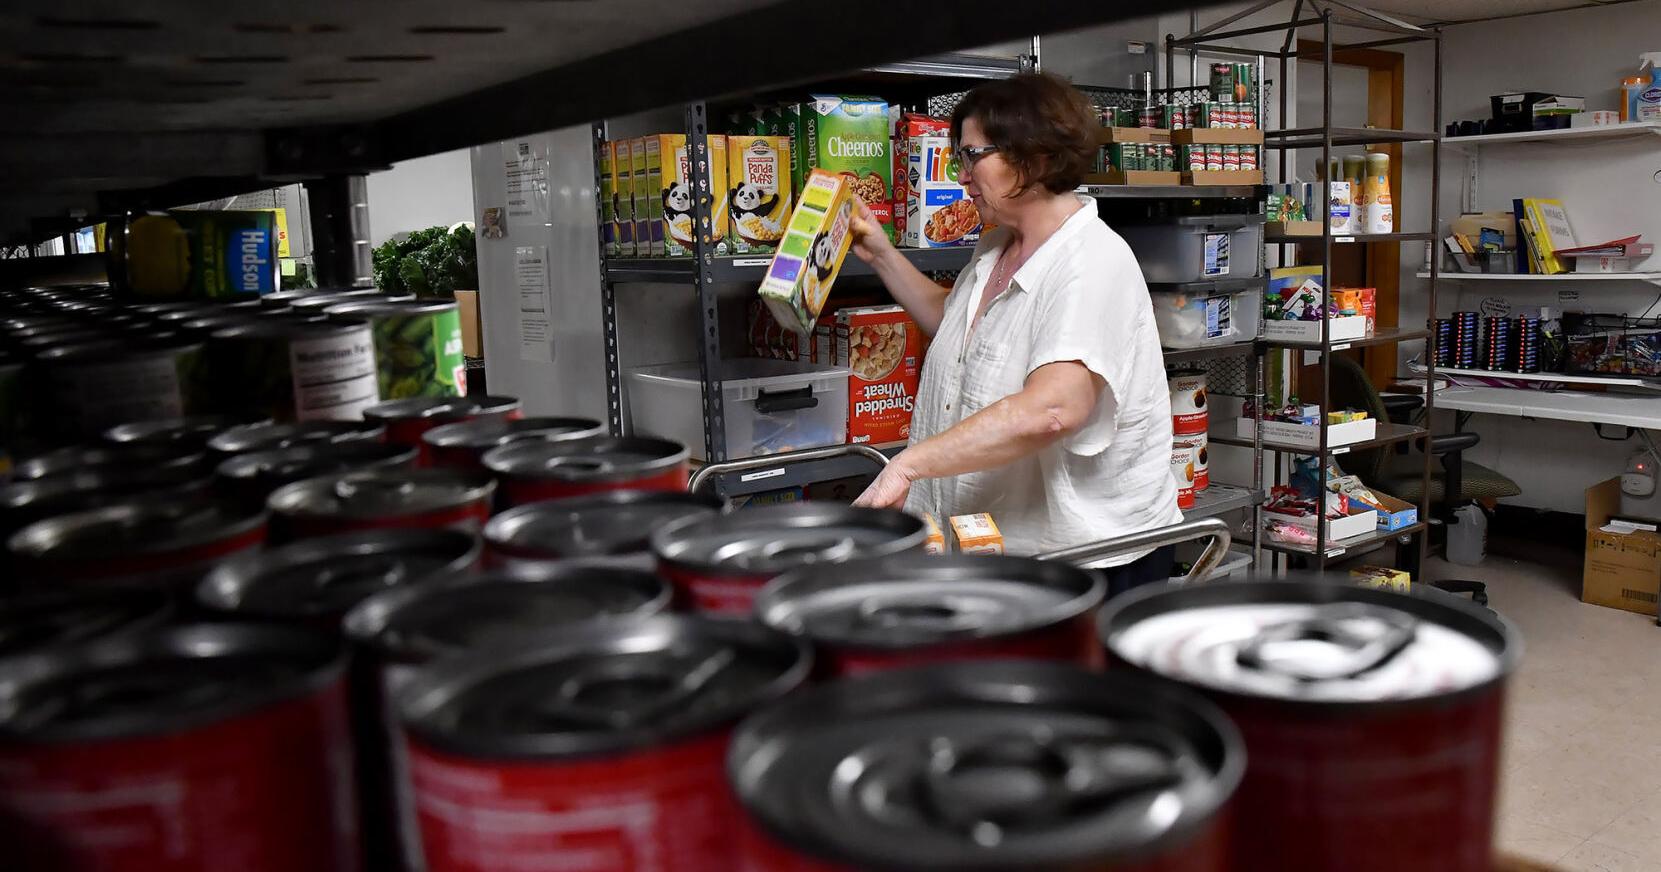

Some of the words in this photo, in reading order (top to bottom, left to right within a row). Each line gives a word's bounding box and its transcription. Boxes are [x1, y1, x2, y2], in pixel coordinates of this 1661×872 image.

[807, 119, 817, 169] Cheerios
[827, 136, 884, 158] Cheerios
[748, 162, 773, 174] Panda
[749, 173, 773, 185] Puffs
[241, 231, 266, 291] Hudson
[863, 382, 906, 399] Wheat
[855, 395, 914, 418] Shredded
